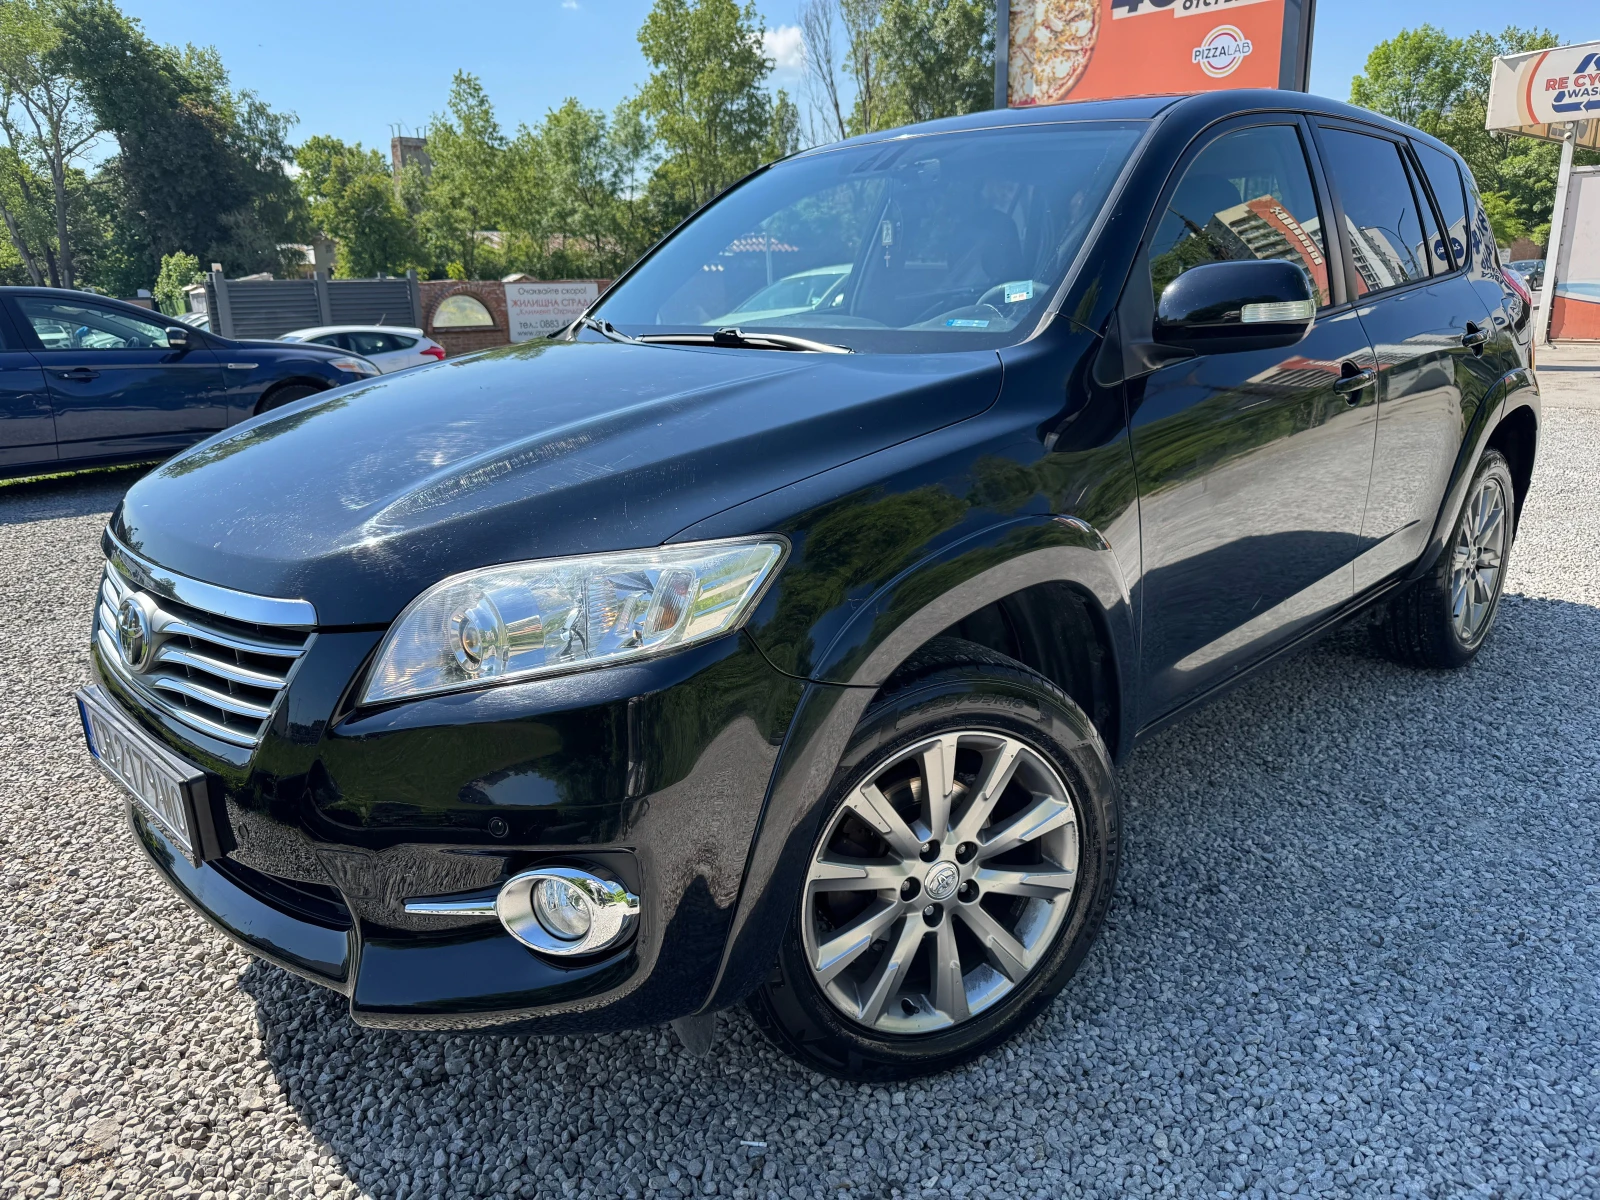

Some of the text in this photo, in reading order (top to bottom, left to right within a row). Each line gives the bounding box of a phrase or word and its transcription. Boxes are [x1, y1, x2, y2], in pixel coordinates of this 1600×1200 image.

[1194, 42, 1250, 61] PIZZALAB
[1545, 73, 1600, 91] RE CY
[1567, 87, 1600, 98] WAS
[511, 299, 559, 307] ЖИЛИЩНА
